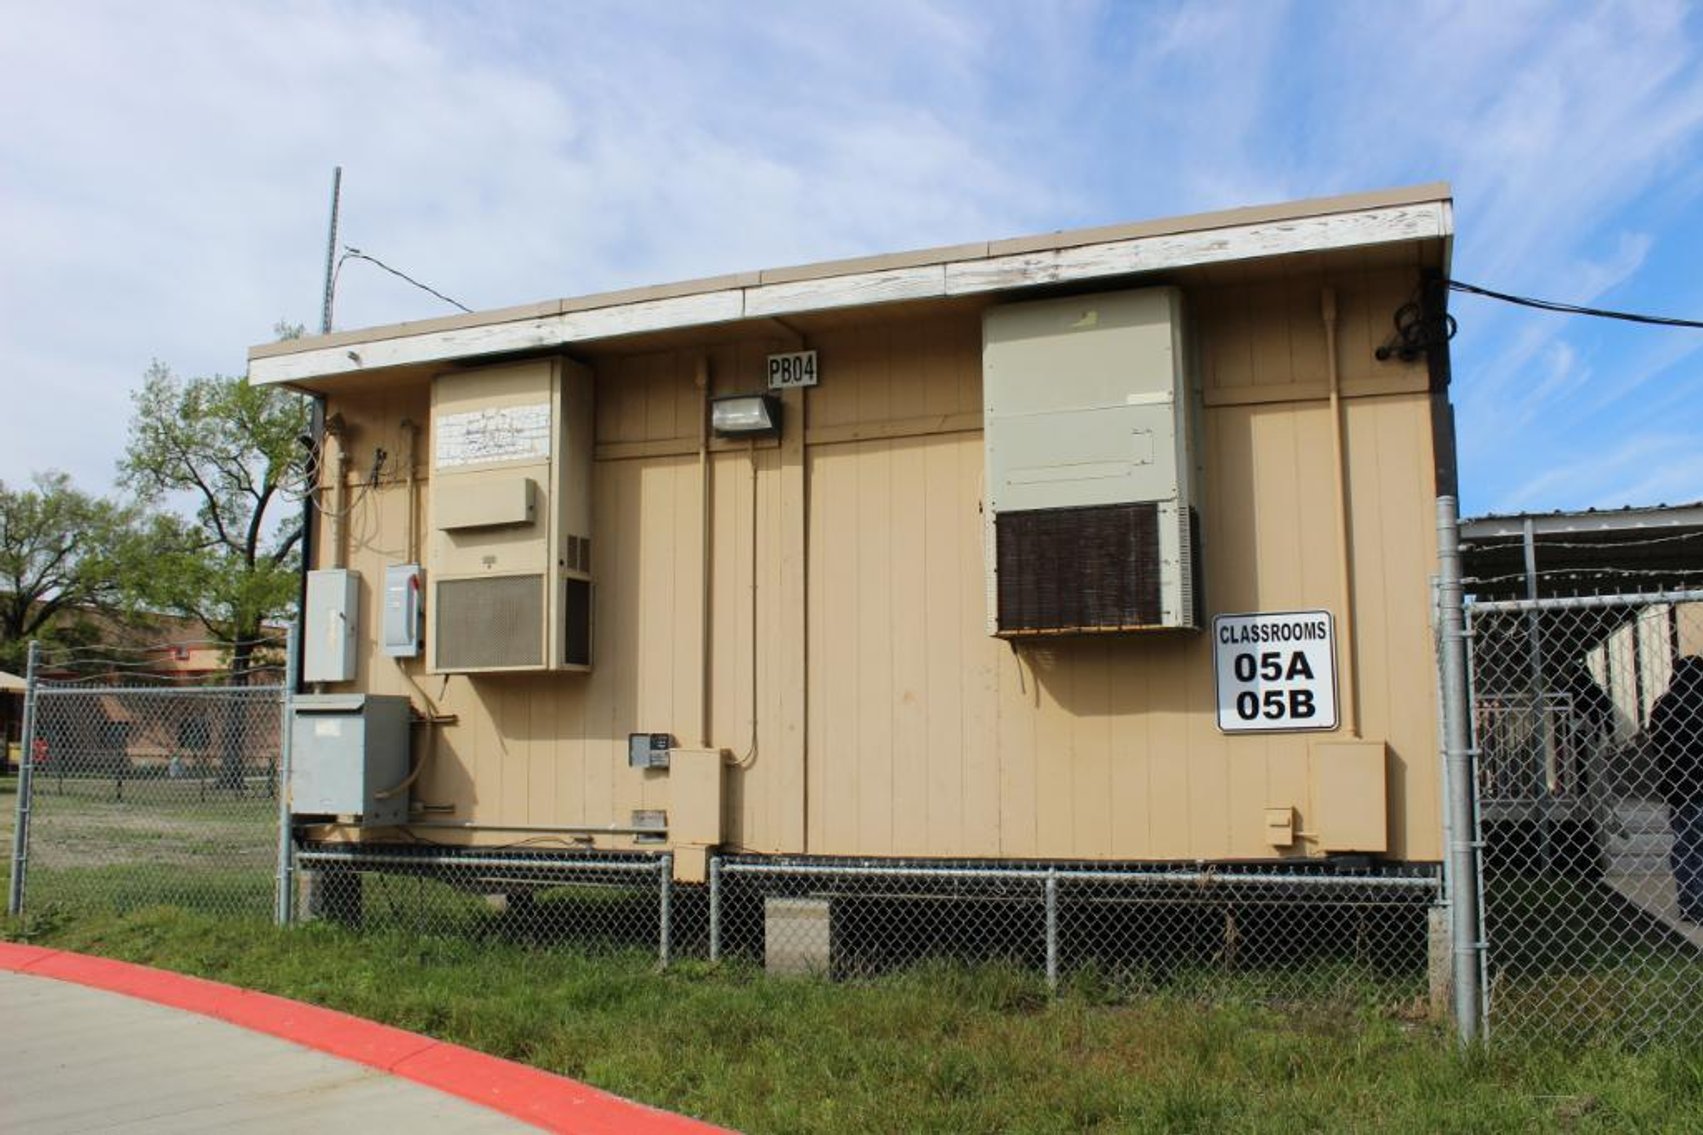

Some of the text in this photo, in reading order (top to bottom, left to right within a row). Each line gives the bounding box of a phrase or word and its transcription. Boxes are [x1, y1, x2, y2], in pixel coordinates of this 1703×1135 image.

[769, 354, 814, 385] PB04
[1220, 621, 1326, 644] CLASSROOMS
[1234, 651, 1315, 682] 05A
[1236, 689, 1316, 720] 05B
